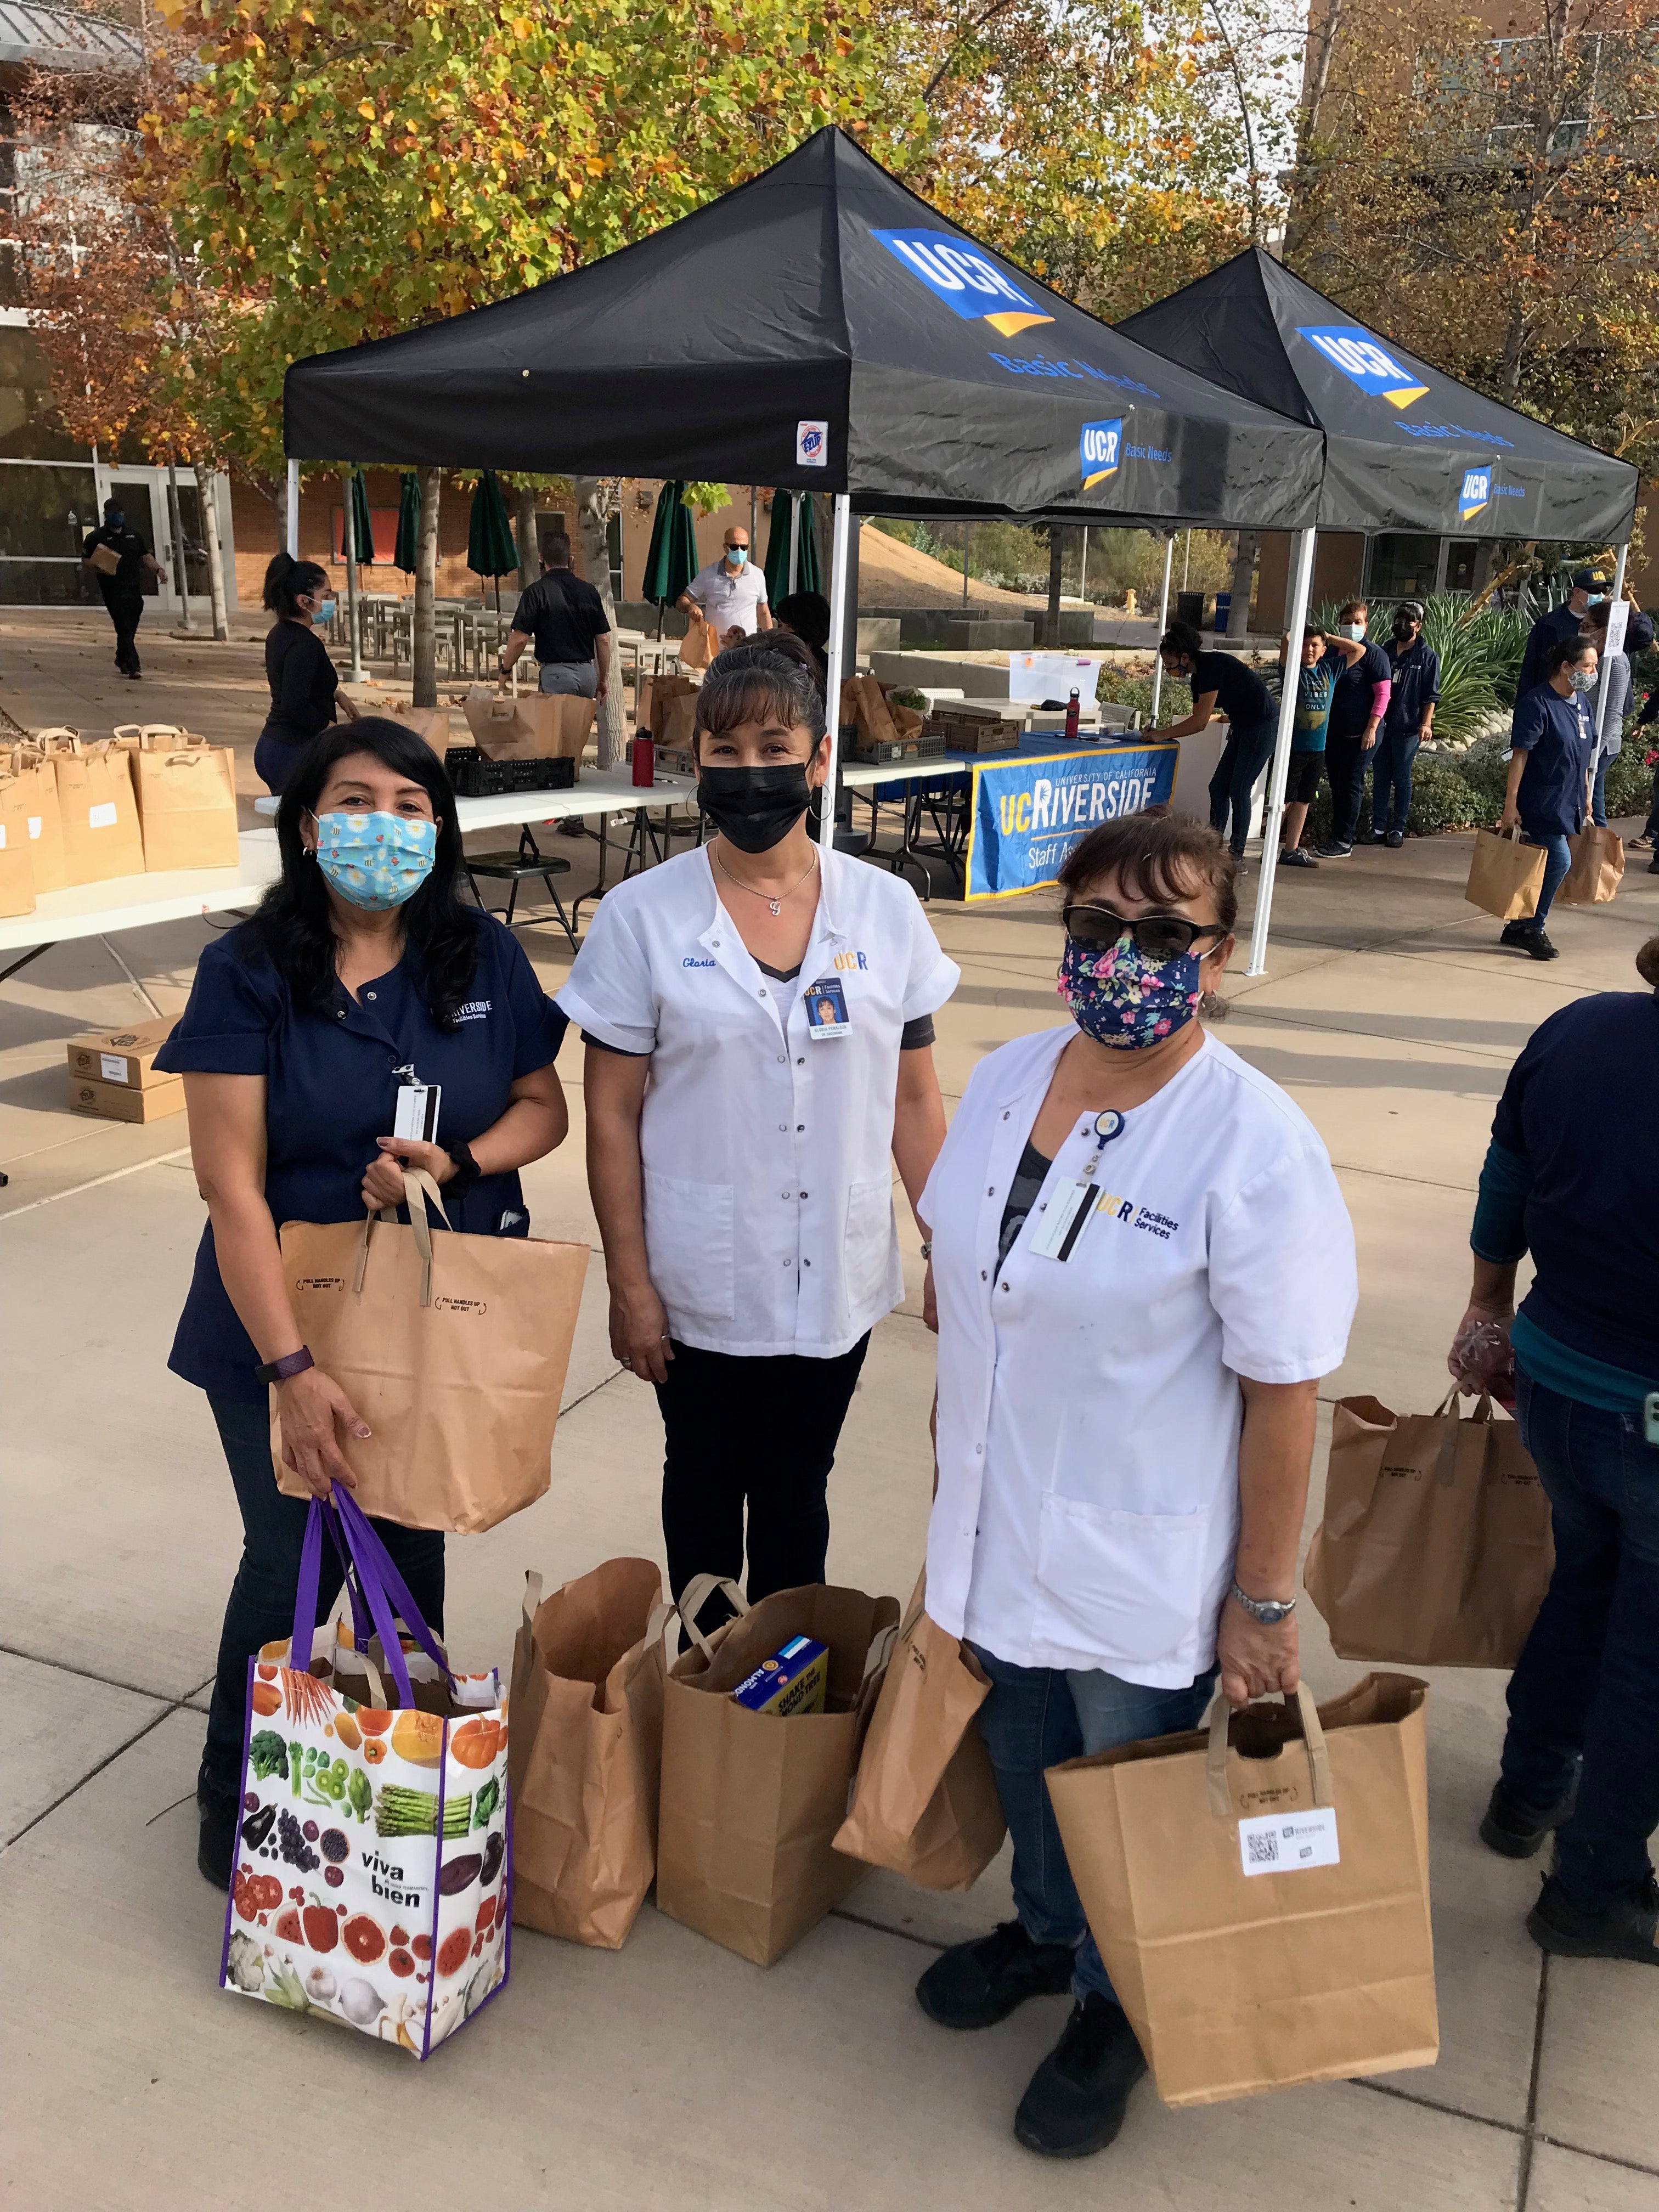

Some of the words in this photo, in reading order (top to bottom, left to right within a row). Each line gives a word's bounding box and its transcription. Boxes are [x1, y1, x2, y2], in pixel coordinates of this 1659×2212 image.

[893, 240, 1034, 307] UCR
[988, 352, 1084, 378] Basic
[1312, 335, 1414, 381] UCR
[1393, 420, 1460, 438] Basic
[1084, 429, 1118, 462] UCR
[1125, 442, 1146, 459] Basic
[1147, 445, 1172, 462] Needs
[1463, 474, 1487, 499] UCR
[1493, 482, 1509, 496] Basic
[1508, 484, 1526, 498] Needs
[1056, 772, 1101, 787] UNIVERSITY
[1103, 771, 1113, 781] OF
[1115, 767, 1157, 781] CALIFORNIA
[1029, 843, 1058, 869] Staff
[682, 957, 716, 967] Gloria
[833, 951, 868, 970] UCR
[1097, 1192, 1133, 1222] UCR
[1139, 1207, 1179, 1231] Facilities
[1134, 1217, 1171, 1240] Services
[735, 1668, 765, 1697] ALMOND
[778, 1677, 805, 1709] SHAKE
[804, 1671, 821, 1694] TREE
[361, 1850, 404, 1882] viva
[371, 1874, 420, 1908] bien
